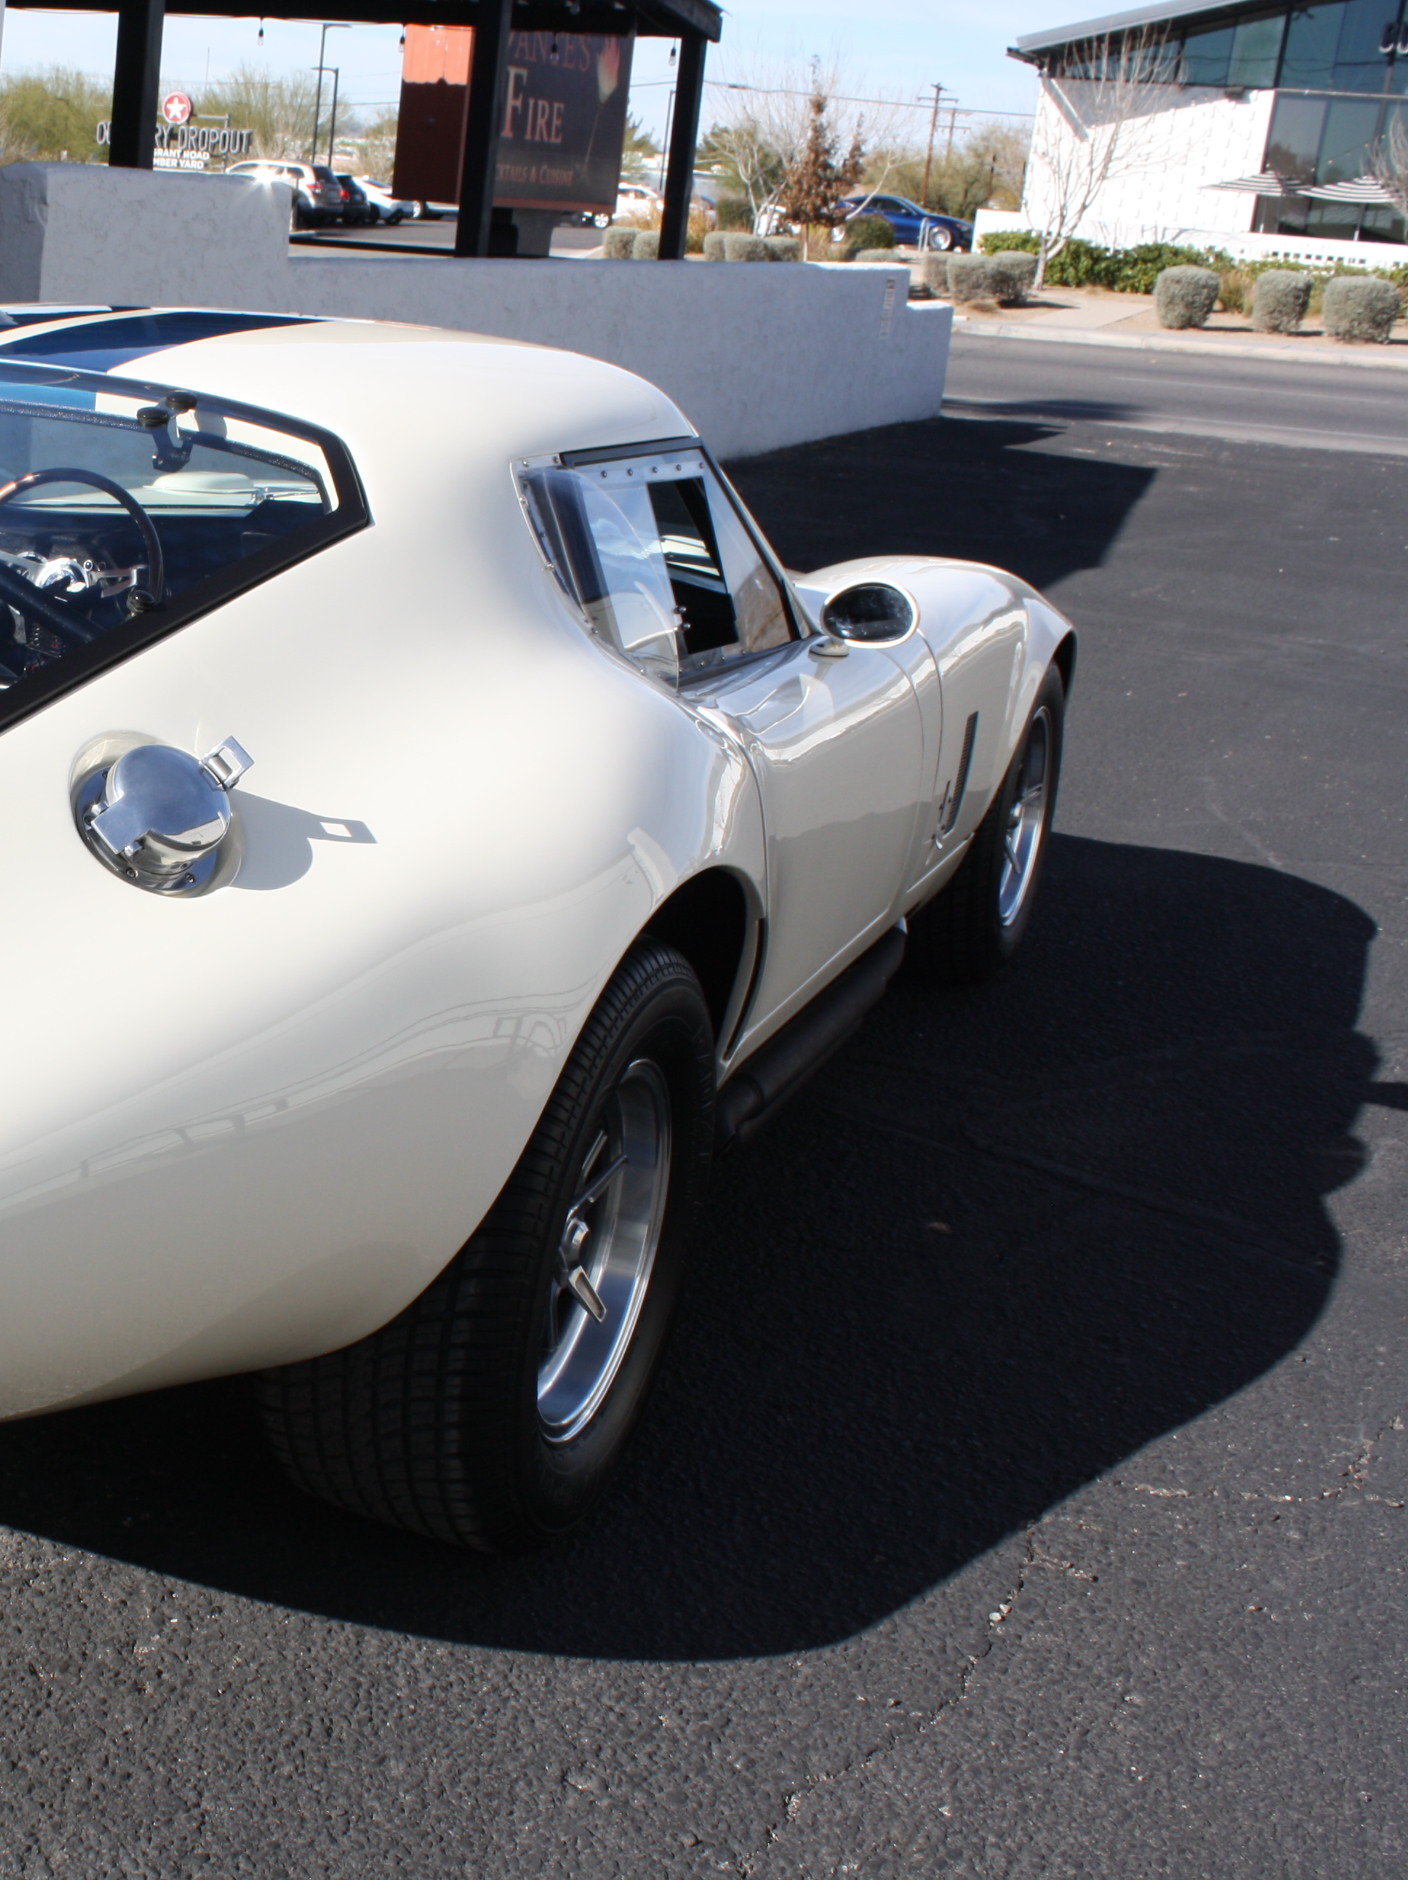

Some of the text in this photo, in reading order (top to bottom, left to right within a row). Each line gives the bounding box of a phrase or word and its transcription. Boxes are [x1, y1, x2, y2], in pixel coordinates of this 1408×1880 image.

[500, 66, 565, 144] FIRE
[177, 125, 254, 155] DROPOUT
[179, 159, 205, 170] YARD
[183, 149, 210, 161] ROAD
